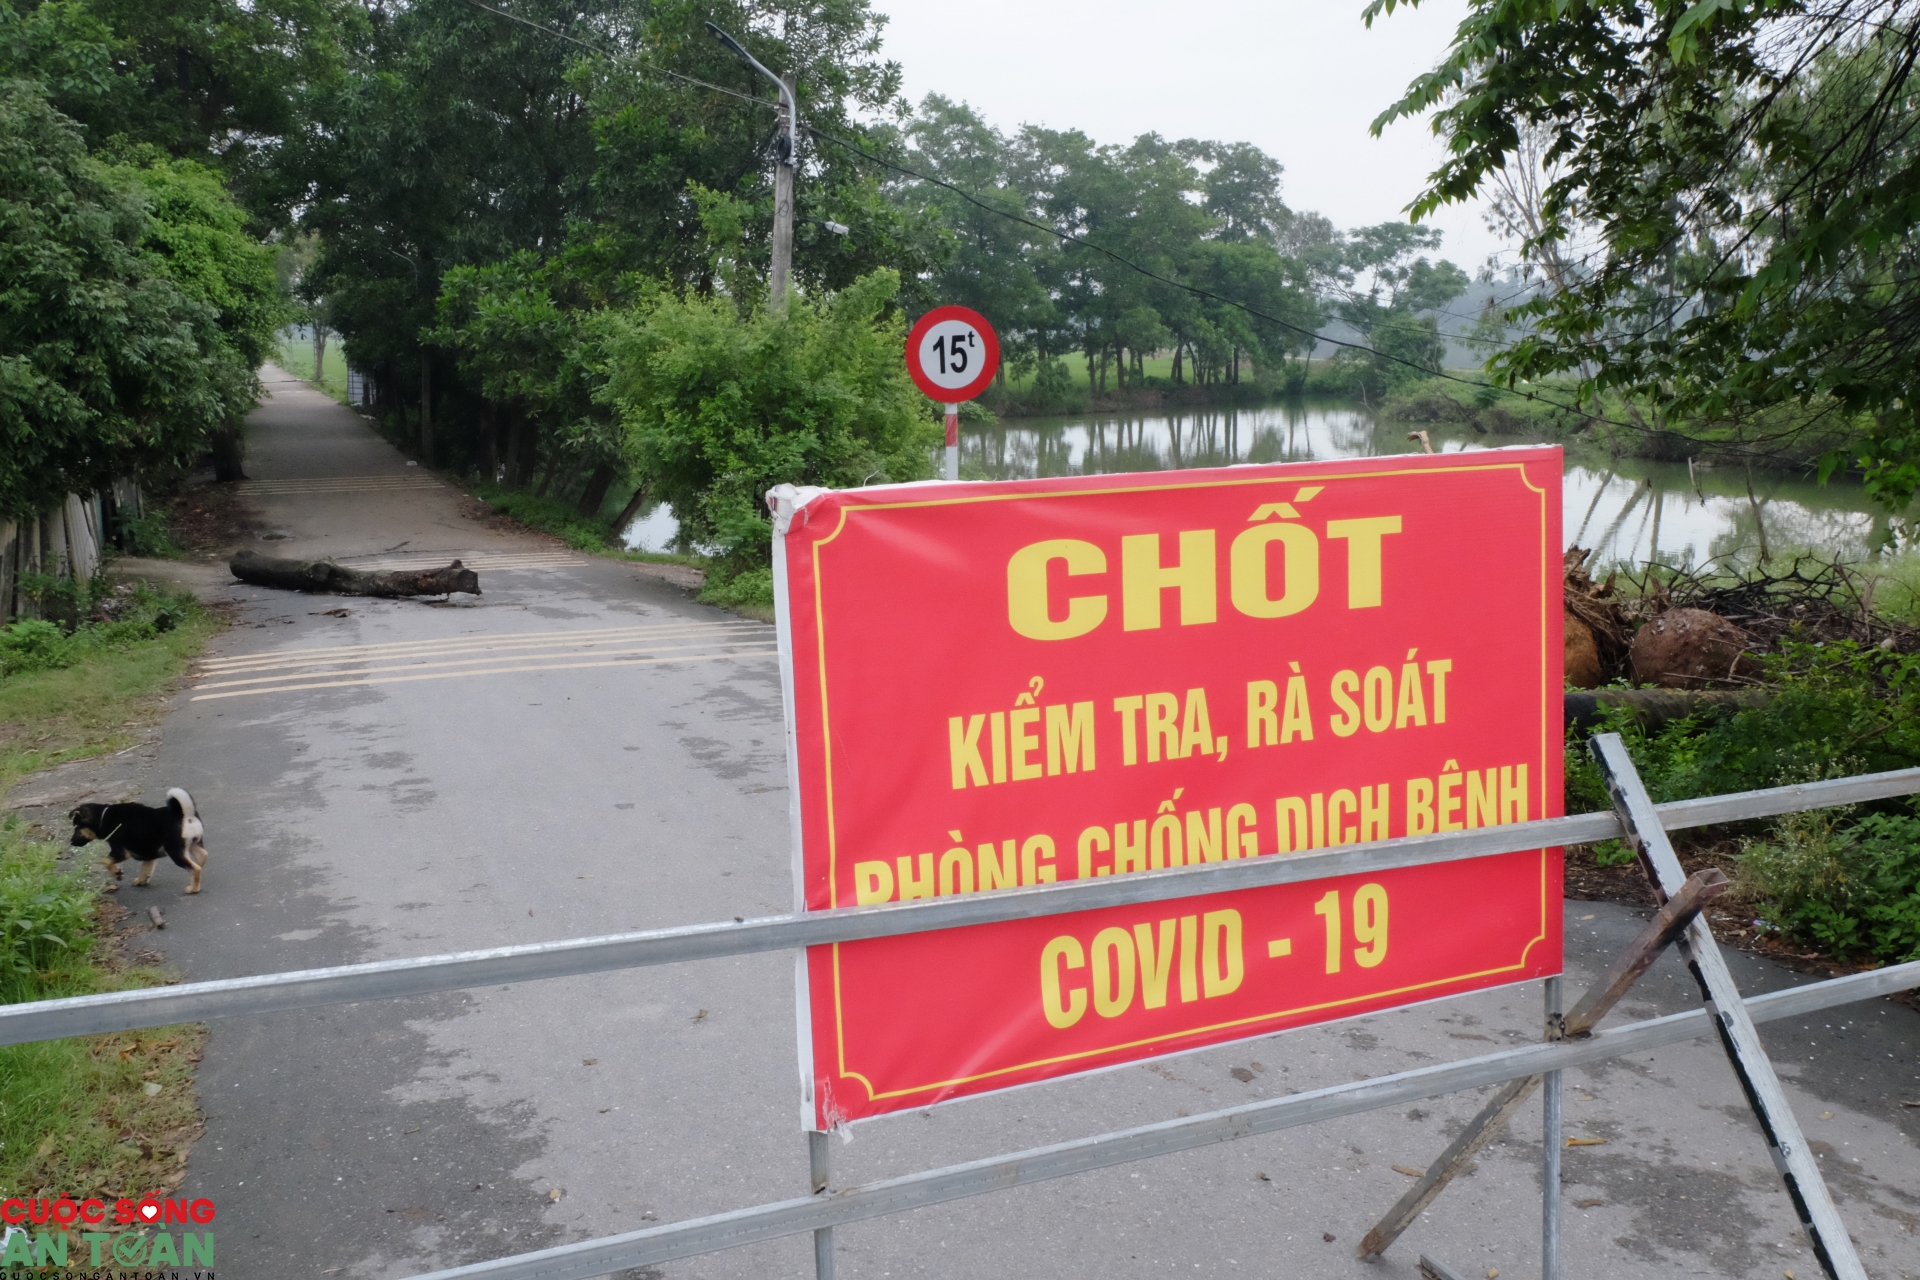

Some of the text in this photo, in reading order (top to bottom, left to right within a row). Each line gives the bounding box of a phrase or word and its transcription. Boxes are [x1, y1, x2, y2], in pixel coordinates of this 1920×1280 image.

[1007, 486, 1402, 641] CHỐT
[948, 647, 1452, 790] KIỂM TRA, RÀ SOÁT
[854, 829, 1057, 907] PHÒNG
[1077, 787, 1259, 880] CHỐNG
[1040, 908, 1245, 1030] COVID
[1314, 883, 1389, 975] 19
